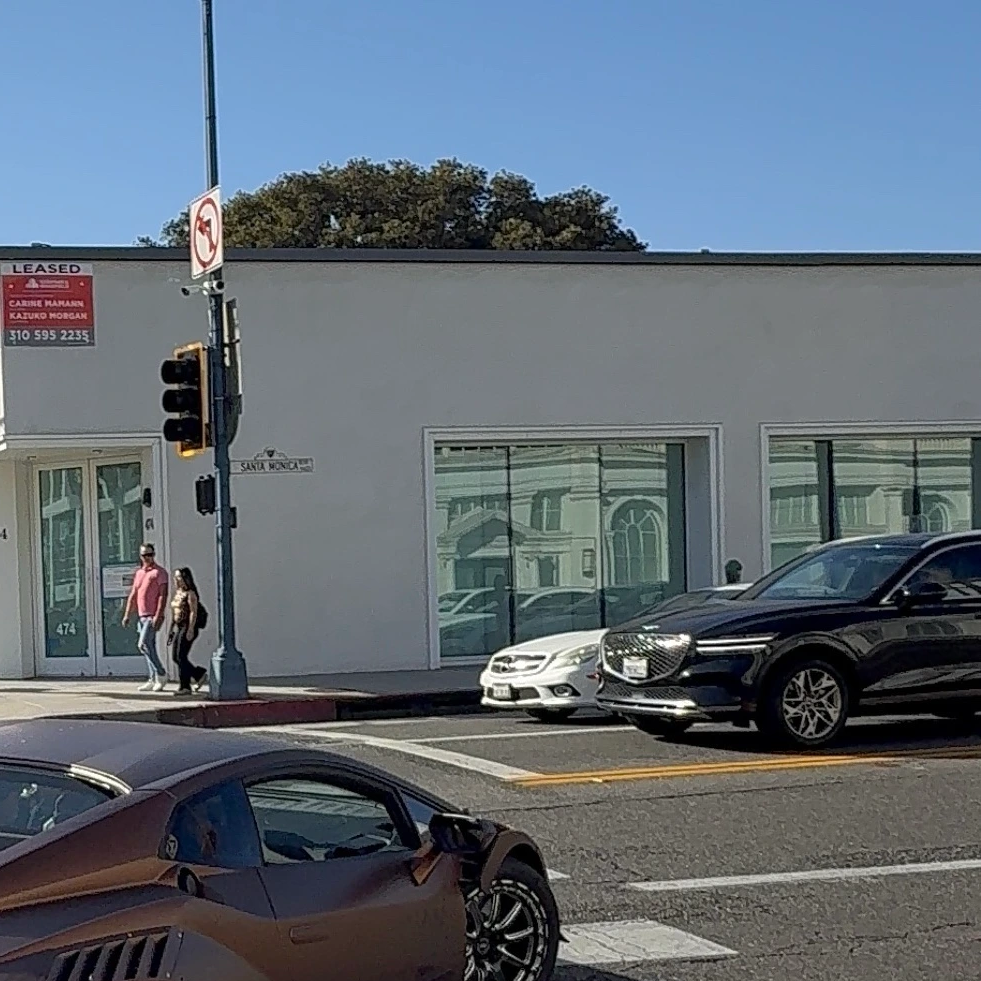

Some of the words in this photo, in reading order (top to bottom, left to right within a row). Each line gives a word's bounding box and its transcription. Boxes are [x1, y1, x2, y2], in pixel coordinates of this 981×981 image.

[13, 264, 81, 274] LEASED
[9, 312, 47, 320] KAZUKO
[49, 312, 88, 320] MORGAN
[9, 329, 30, 341] 310
[34, 329, 56, 341] 595
[60, 329, 89, 341] 2235
[240, 462, 266, 472] SANTA
[268, 461, 299, 471] MONICA
[56, 622, 77, 636] 474
